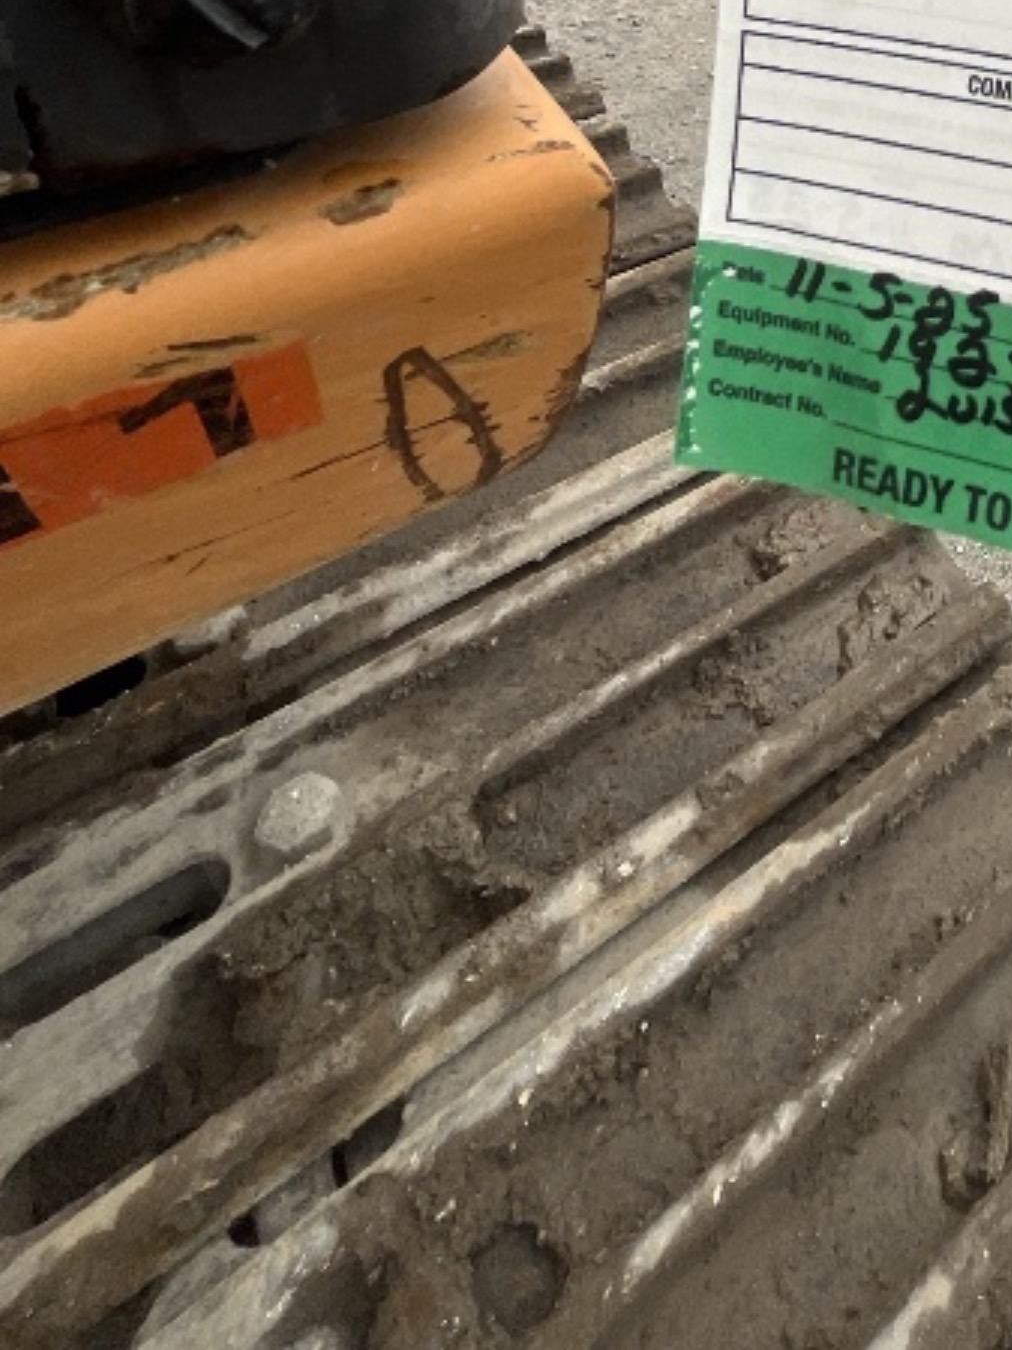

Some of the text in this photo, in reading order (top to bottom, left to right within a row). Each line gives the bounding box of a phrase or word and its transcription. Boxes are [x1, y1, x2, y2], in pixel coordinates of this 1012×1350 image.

[717, 298, 857, 347] Equipment No.
[712, 337, 883, 396] Employee's Name
[707, 377, 829, 420] Contract No.
[832, 446, 957, 516] READY
[963, 482, 1012, 534] TO
